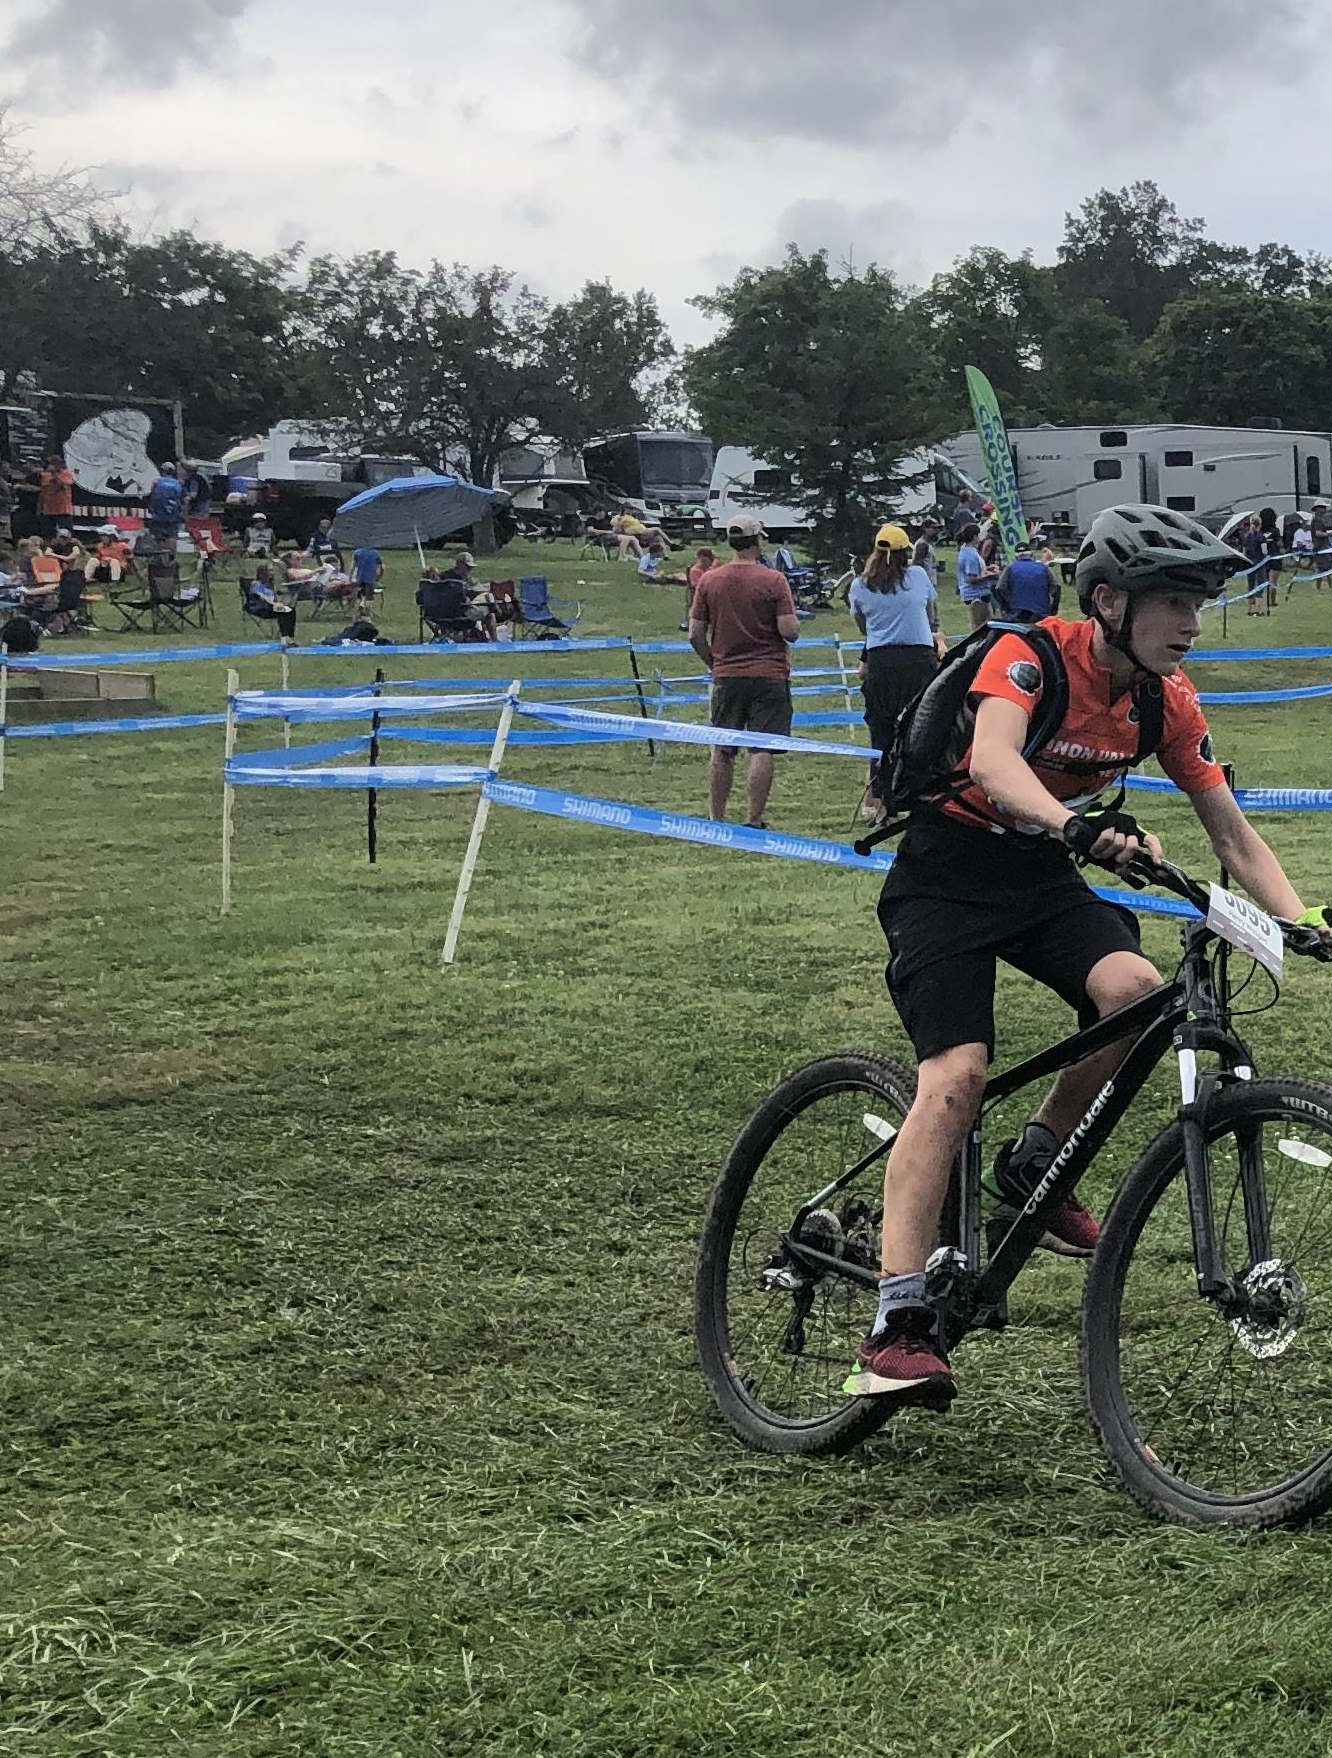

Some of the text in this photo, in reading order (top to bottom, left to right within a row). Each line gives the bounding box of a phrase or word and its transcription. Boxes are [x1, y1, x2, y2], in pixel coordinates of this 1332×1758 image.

[978, 404, 1020, 546] CROSSING
[562, 797, 632, 825] SHIMANO
[659, 815, 733, 842] SHIMANO
[763, 835, 841, 862] SHIMANO
